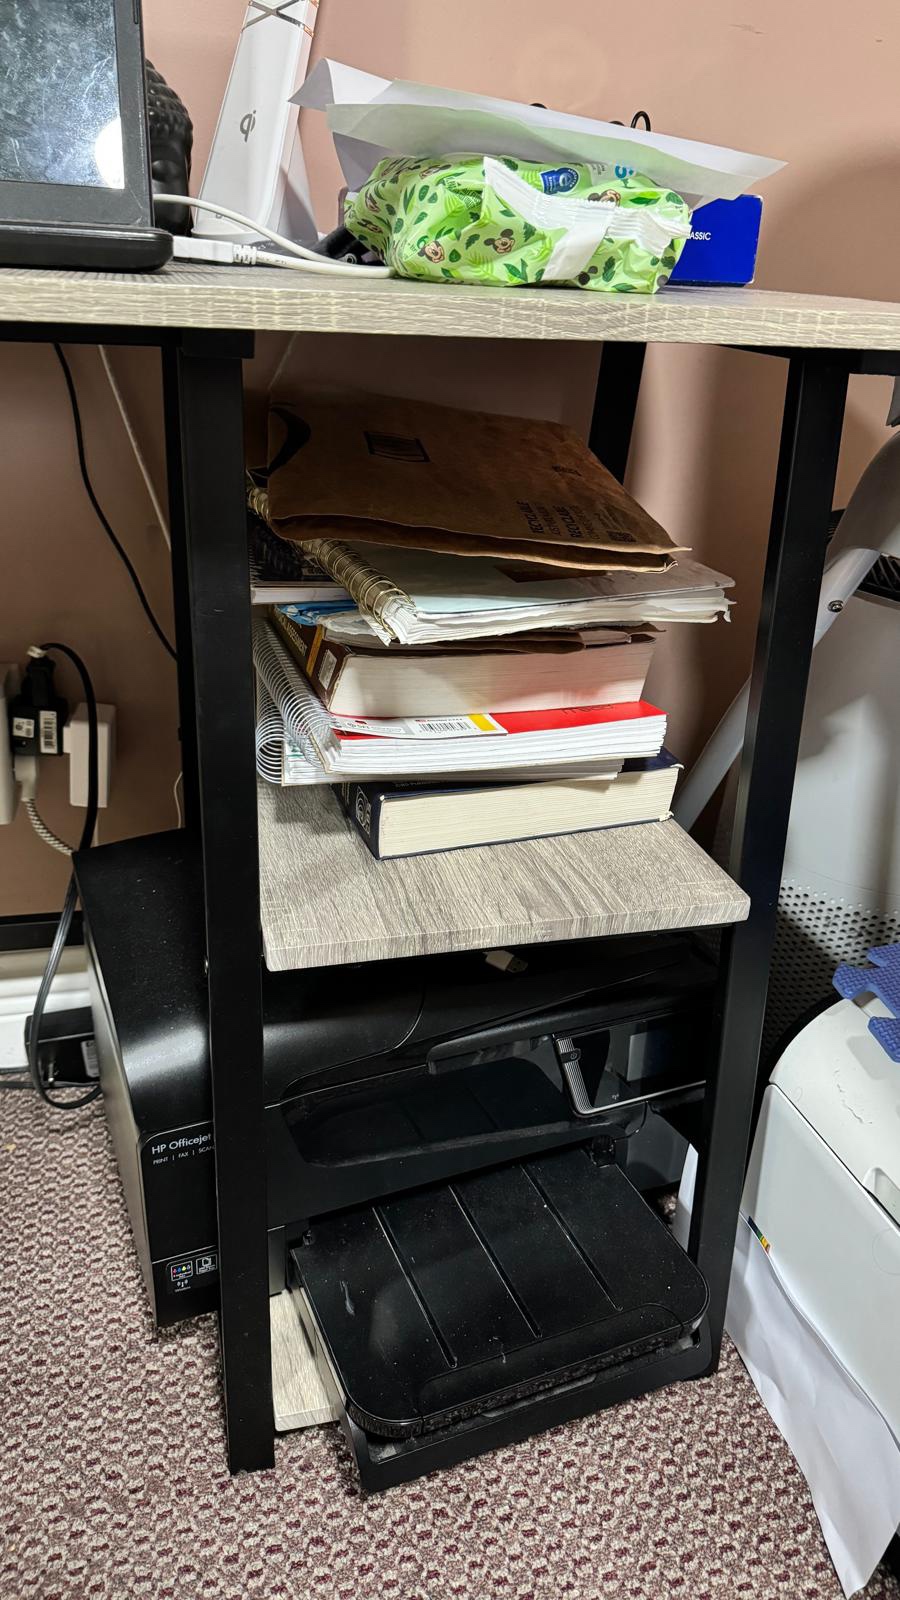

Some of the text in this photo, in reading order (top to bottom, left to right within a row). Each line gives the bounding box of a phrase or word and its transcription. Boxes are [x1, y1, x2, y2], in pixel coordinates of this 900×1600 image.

[689, 231, 711, 240] ASSIC
[152, 1133, 212, 1155] HP Officejet
[153, 1156, 169, 1165] PRINT
[178, 1151, 189, 1159] FAX
